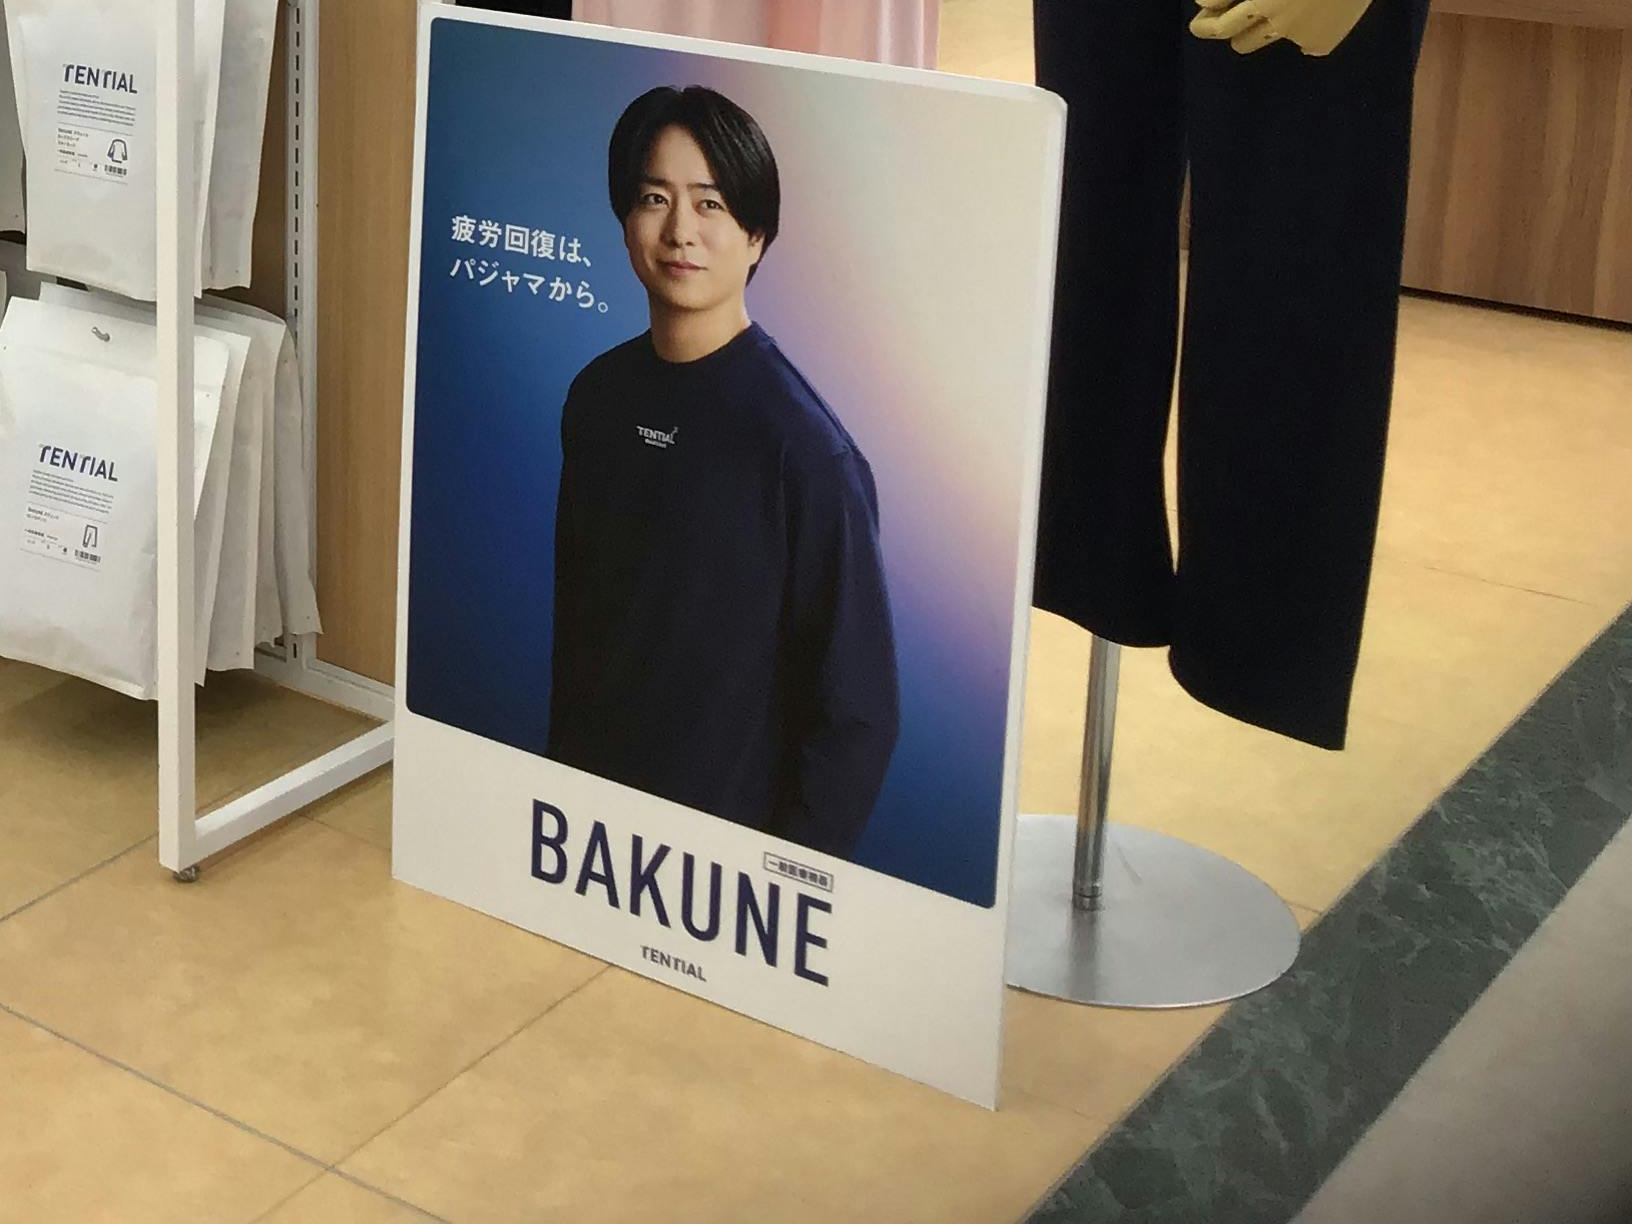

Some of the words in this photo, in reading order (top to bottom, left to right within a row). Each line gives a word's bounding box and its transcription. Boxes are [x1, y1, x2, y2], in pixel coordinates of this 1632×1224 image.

[62, 63, 139, 95] TENTIAL
[449, 214, 592, 268] 疲労回復は、
[449, 256, 610, 314] パジャマから。
[37, 442, 119, 482] TENTIAL
[531, 798, 833, 987] BAKUNE
[640, 944, 708, 982] TENTIAL
